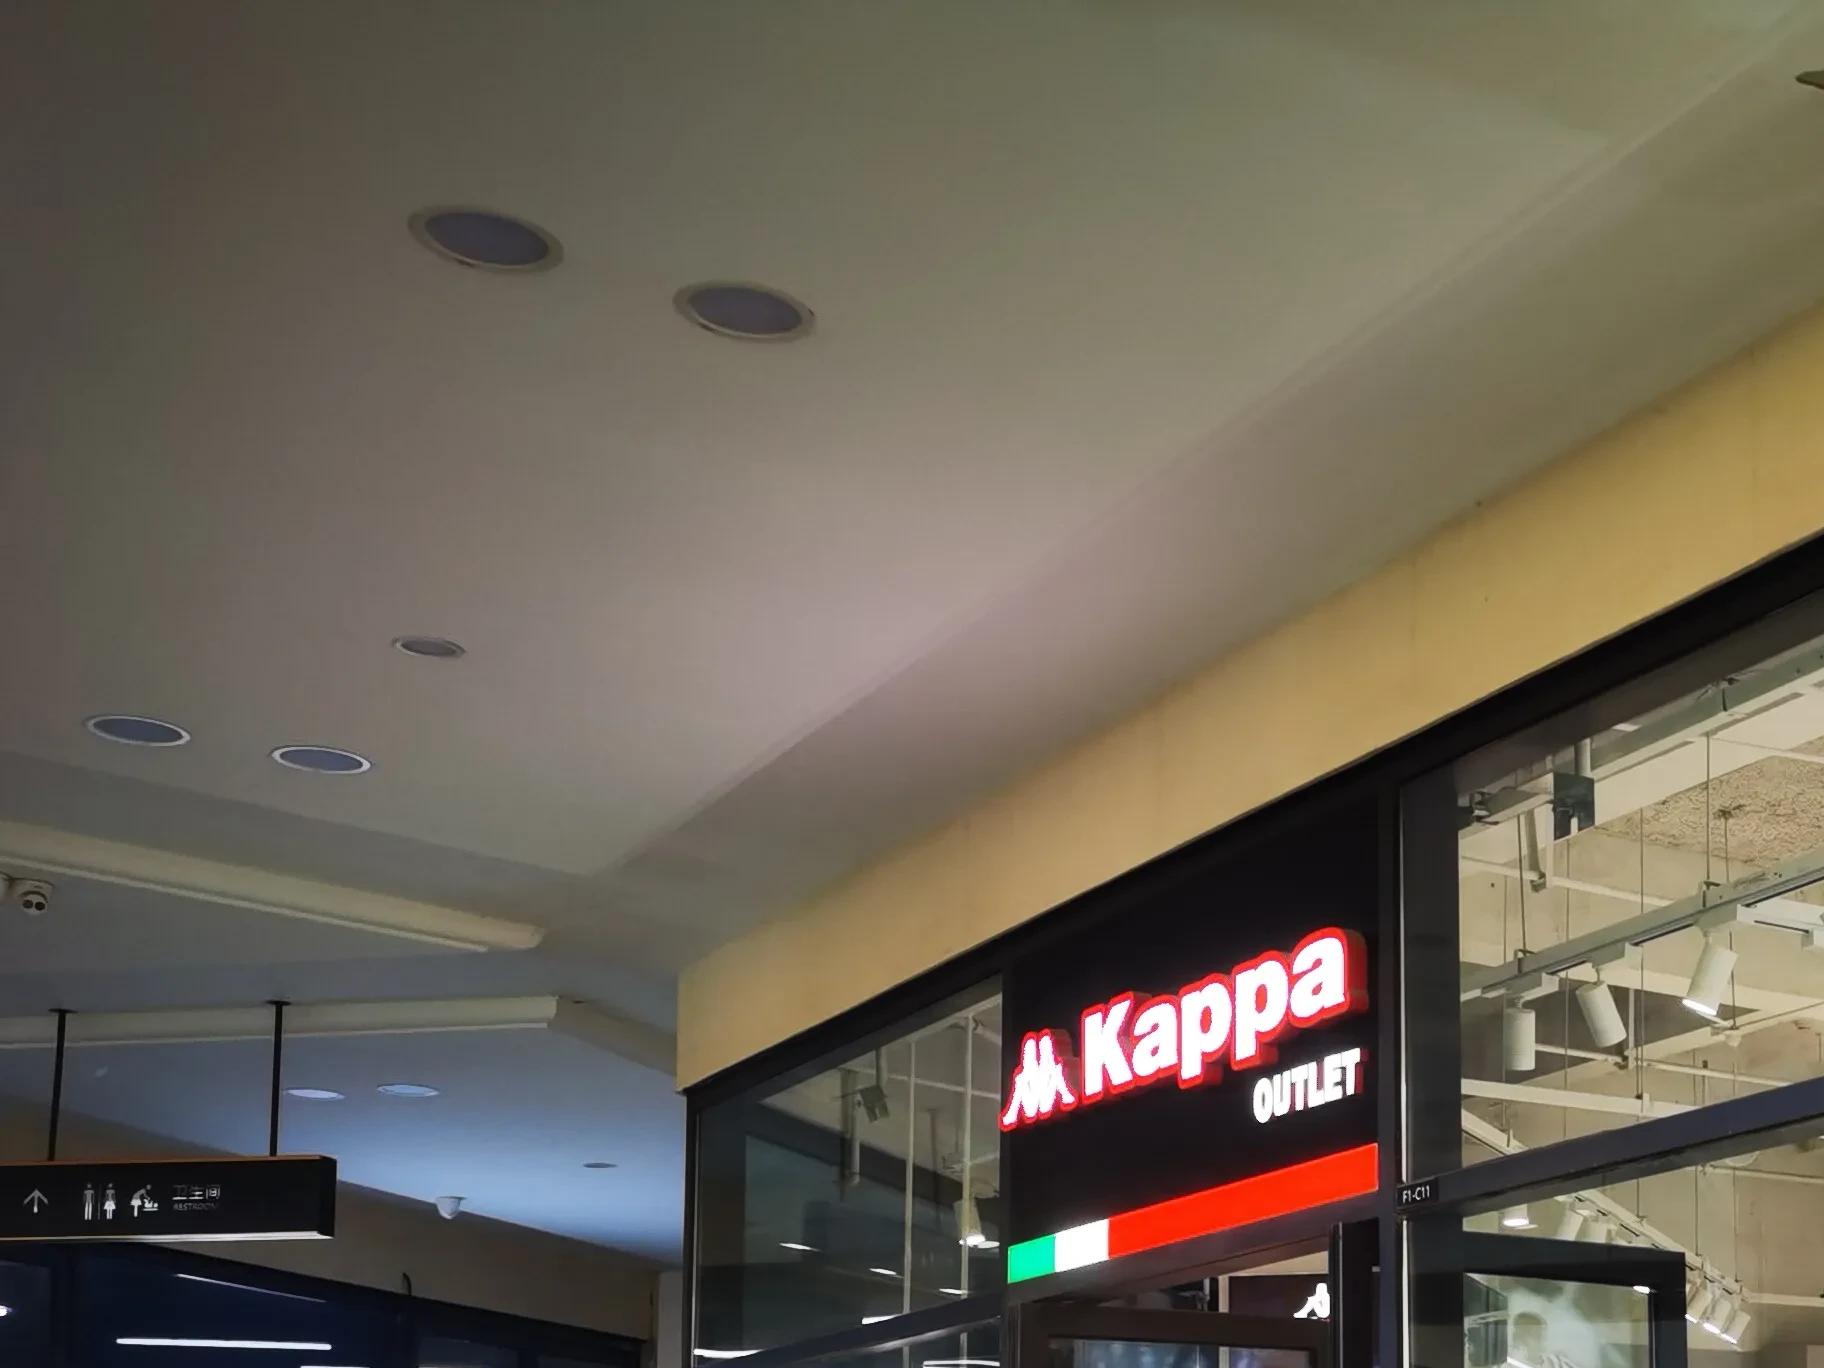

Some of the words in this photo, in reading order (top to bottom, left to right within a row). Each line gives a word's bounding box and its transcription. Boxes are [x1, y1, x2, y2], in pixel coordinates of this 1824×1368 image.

[1079, 926, 1352, 1101] Kappa
[1252, 1047, 1363, 1124] OUTLET
[172, 1184, 221, 1200] 卫生间
[1402, 1184, 1430, 1204] F1-C11
